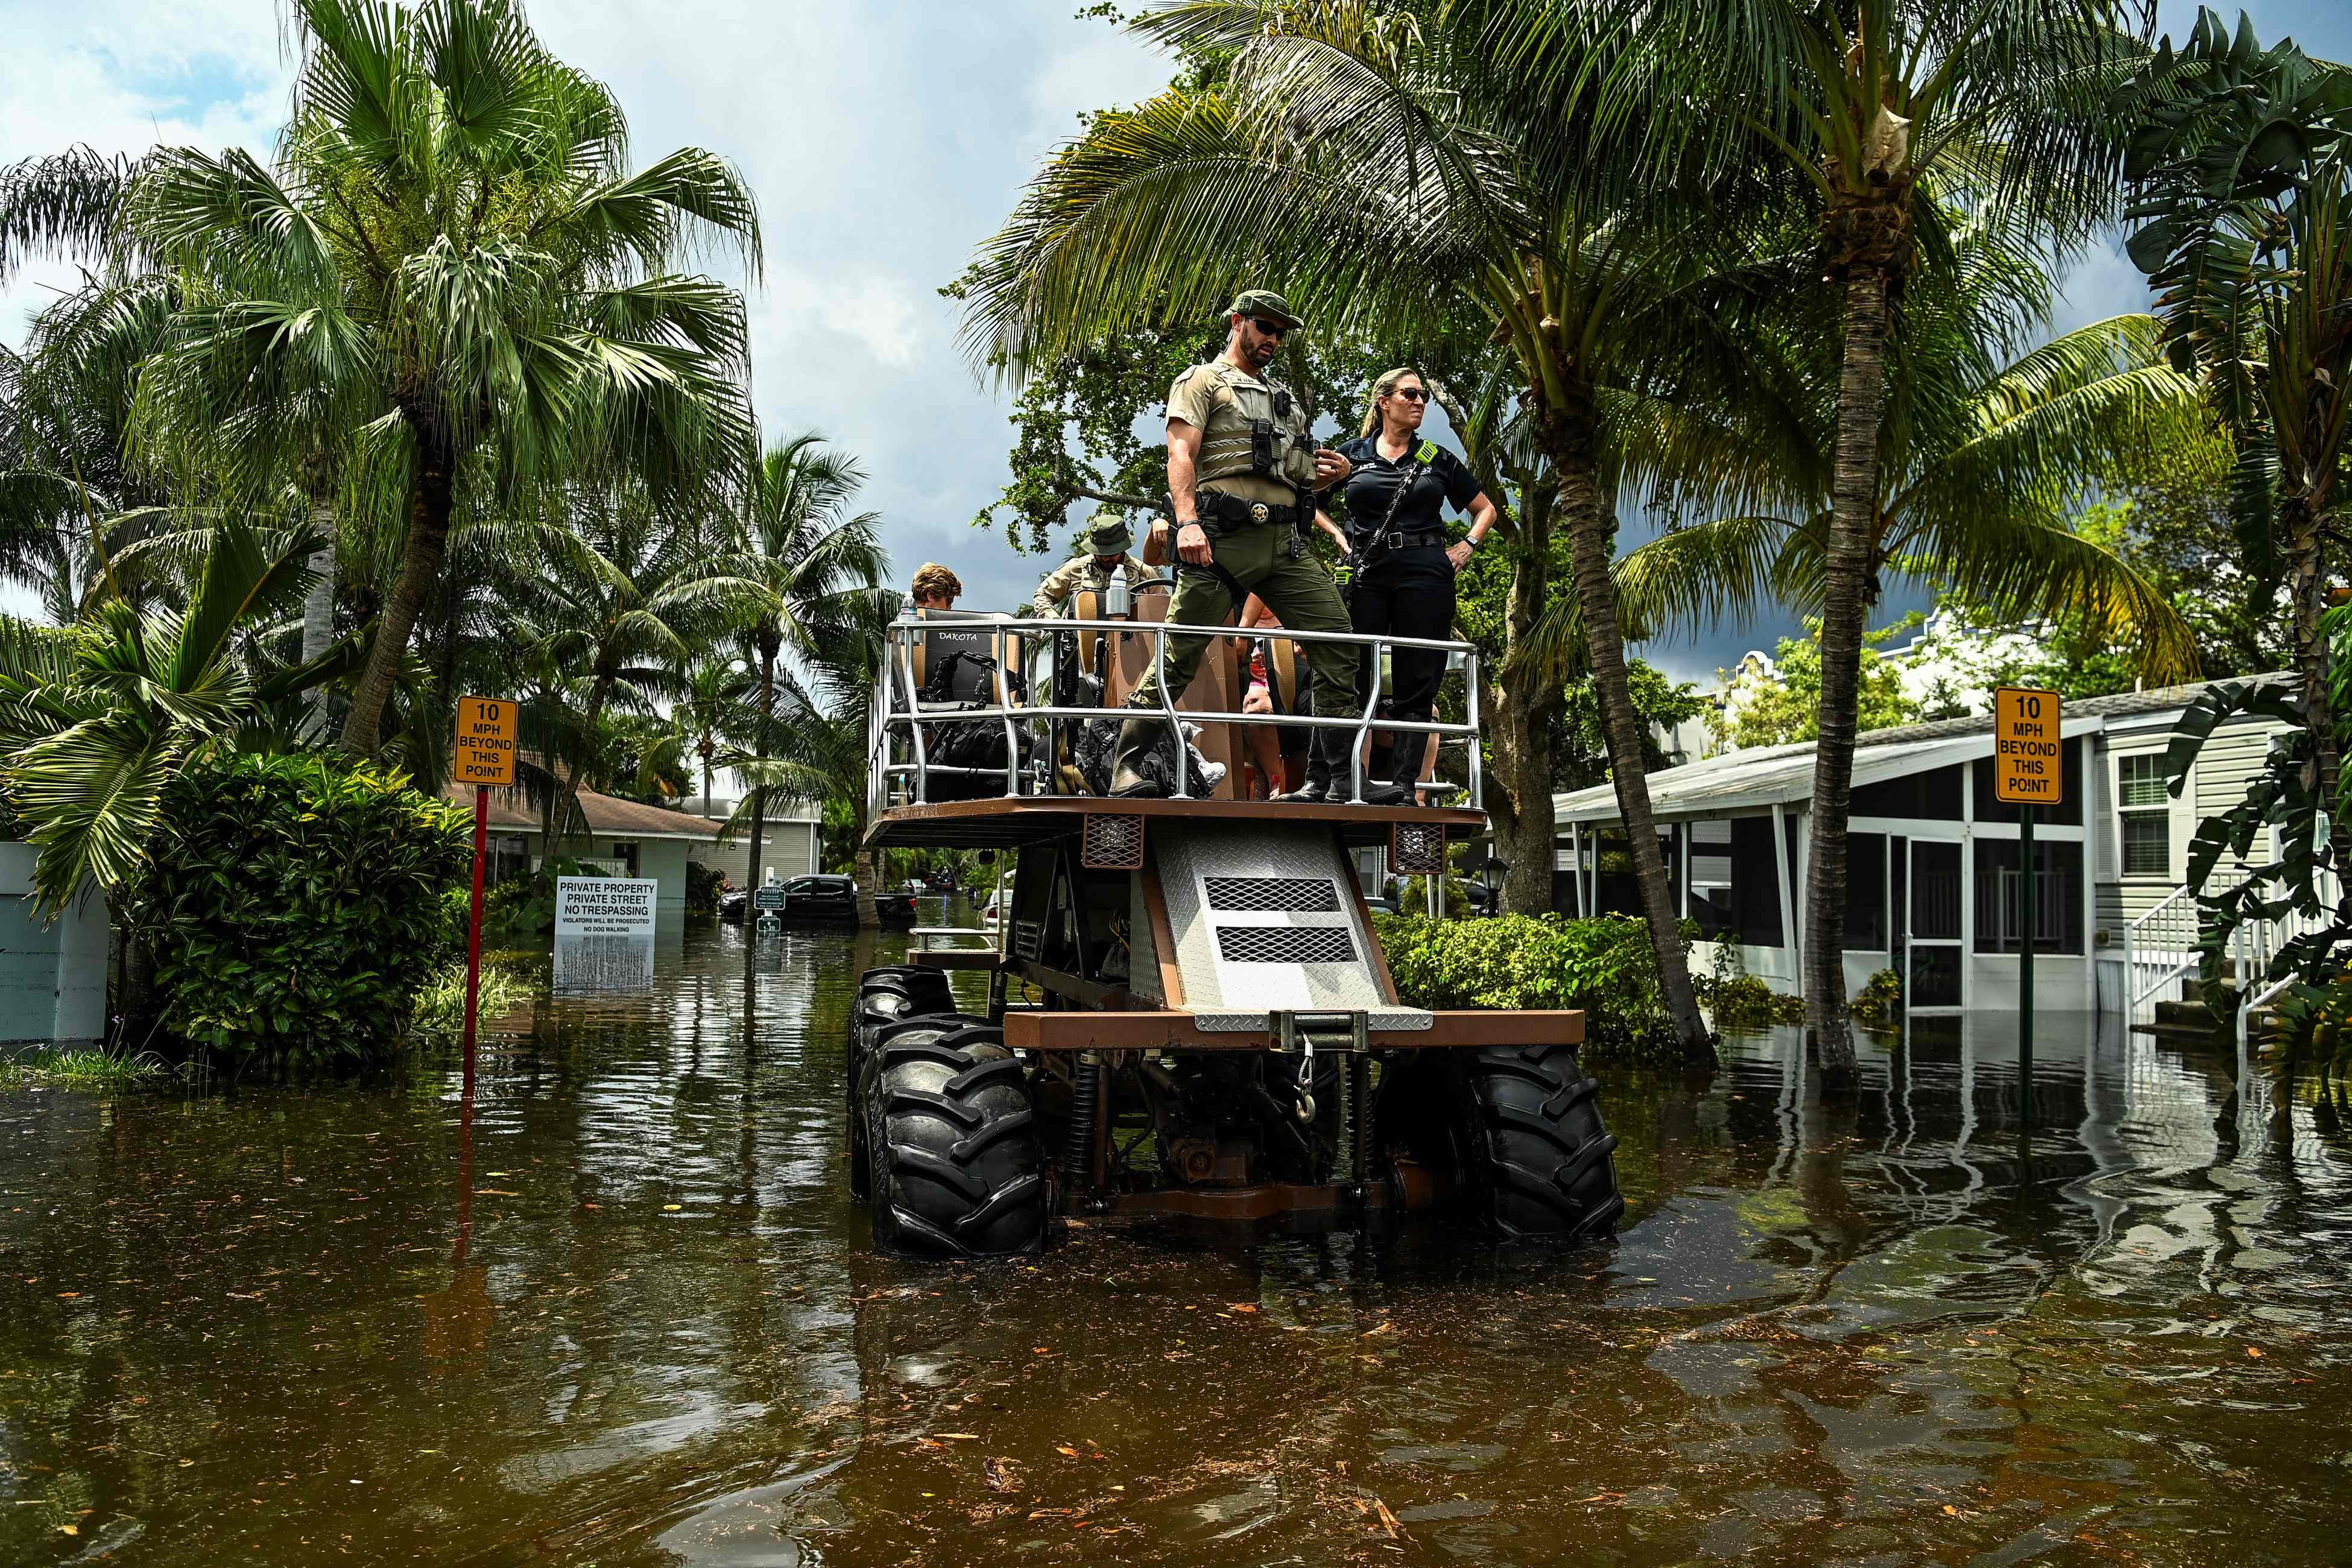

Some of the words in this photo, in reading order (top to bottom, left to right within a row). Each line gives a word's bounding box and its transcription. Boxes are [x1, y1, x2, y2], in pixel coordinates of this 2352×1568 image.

[938, 632, 978, 641] DAKOTA
[477, 703, 499, 721] 10
[2016, 695, 2041, 719] 10
[473, 723, 501, 735] MPH
[2013, 722, 2043, 738] MPH
[460, 736, 512, 750] BEYOND
[2000, 739, 2057, 757] BEYOND
[471, 751, 499, 763] THIS
[466, 765, 504, 777] POINT
[2013, 759, 2044, 774] THIS
[2009, 777, 2050, 793] POINT
[560, 882, 601, 892] PRIVATE
[604, 884, 655, 894] PROPERTY
[567, 894, 608, 903] PRIVATE
[610, 894, 648, 905] STREET
[565, 905, 580, 914] NO
[581, 905, 648, 915] TRESPASSING
